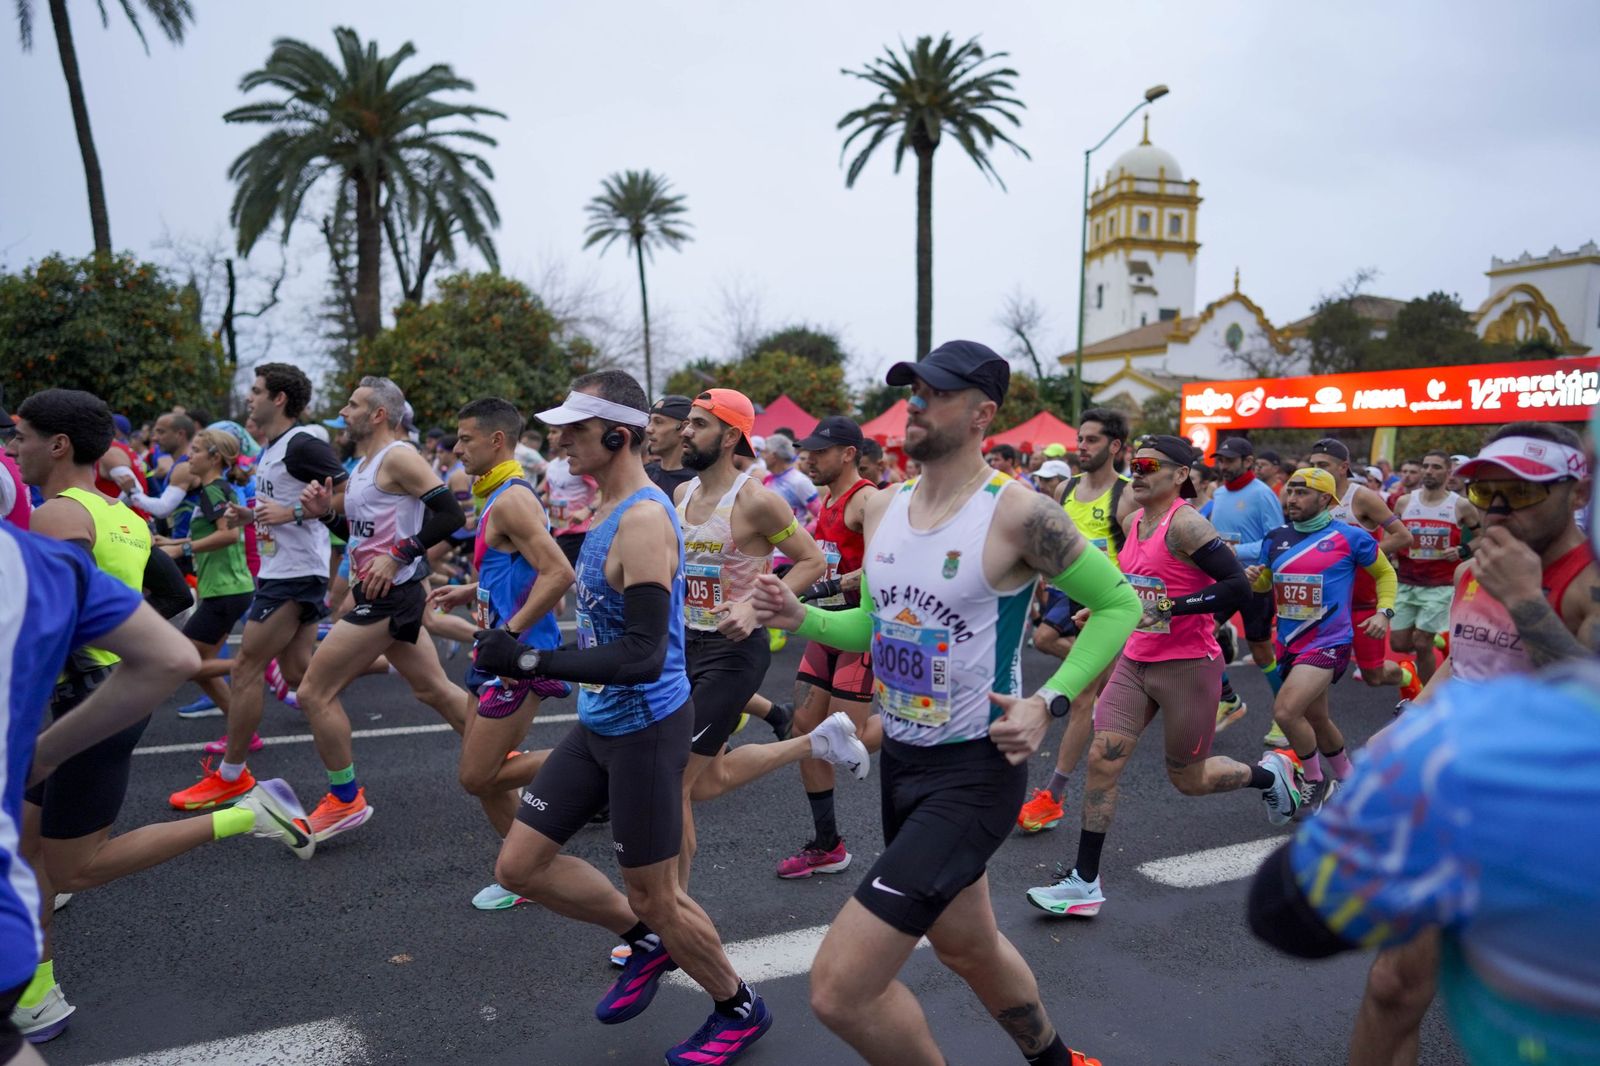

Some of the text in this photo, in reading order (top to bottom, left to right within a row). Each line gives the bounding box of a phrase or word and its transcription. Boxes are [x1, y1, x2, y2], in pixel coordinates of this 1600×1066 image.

[1495, 369, 1598, 393] maratón
[1420, 535, 1439, 546] 937
[1284, 585, 1307, 600] 875
[879, 586, 897, 607] DE
[903, 585, 975, 644] ATLETISMO
[876, 641, 925, 680] 3068
